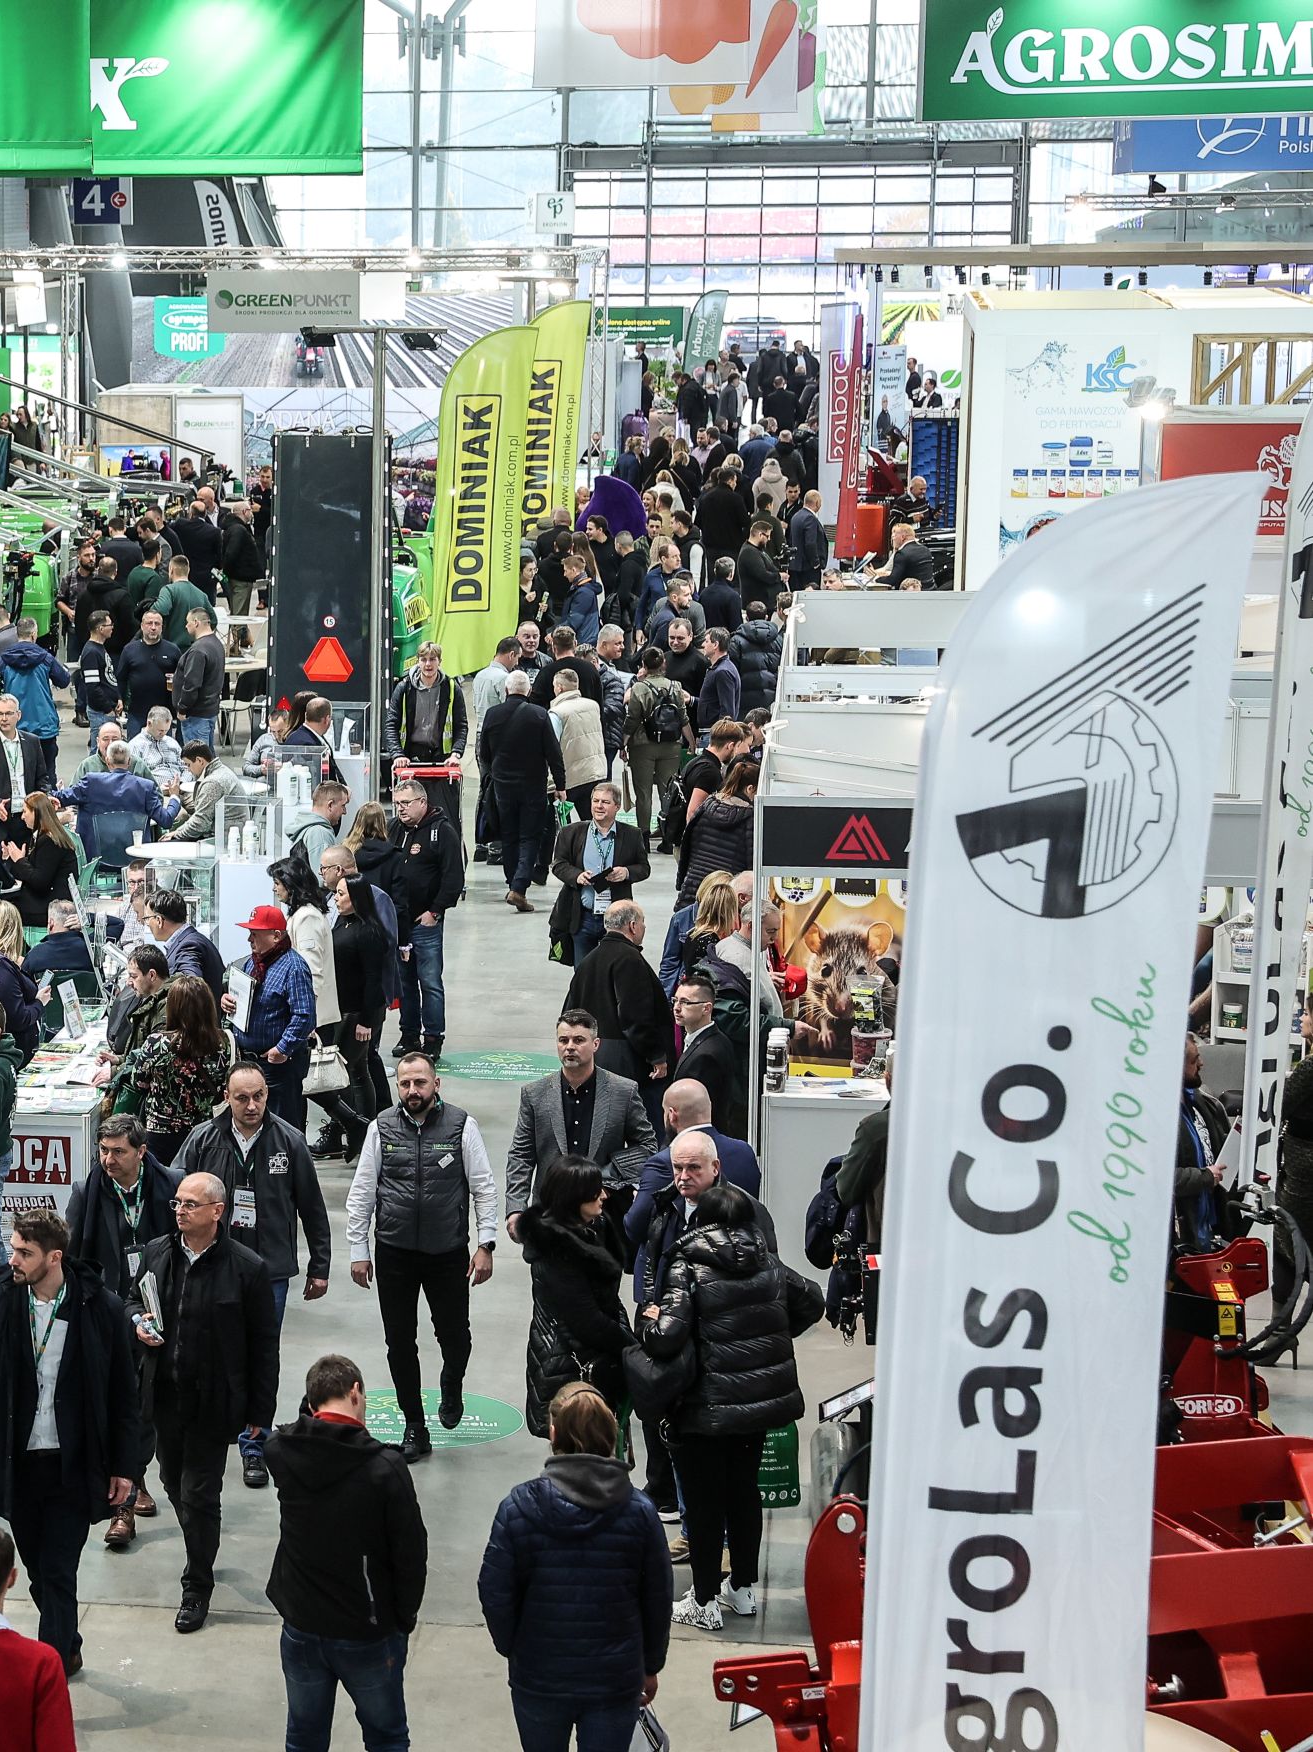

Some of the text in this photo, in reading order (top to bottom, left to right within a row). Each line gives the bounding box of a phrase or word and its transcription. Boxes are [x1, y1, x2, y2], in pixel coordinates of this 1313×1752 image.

[81, 184, 106, 217] 4
[235, 293, 352, 307] GREENPUNKT
[171, 332, 208, 352] PROFI
[691, 317, 707, 358] Arbuzy
[253, 410, 336, 431] PADANA
[1035, 407, 1067, 416] GAMA
[1040, 420, 1057, 429] DO
[451, 402, 494, 602] DOMINIAK
[501, 434, 519, 573] www.dominiak.com.pl
[326, 618, 334, 626] 15
[947, 1024, 1072, 1237] Co.
[1066, 962, 1157, 1284] od 1990 roku
